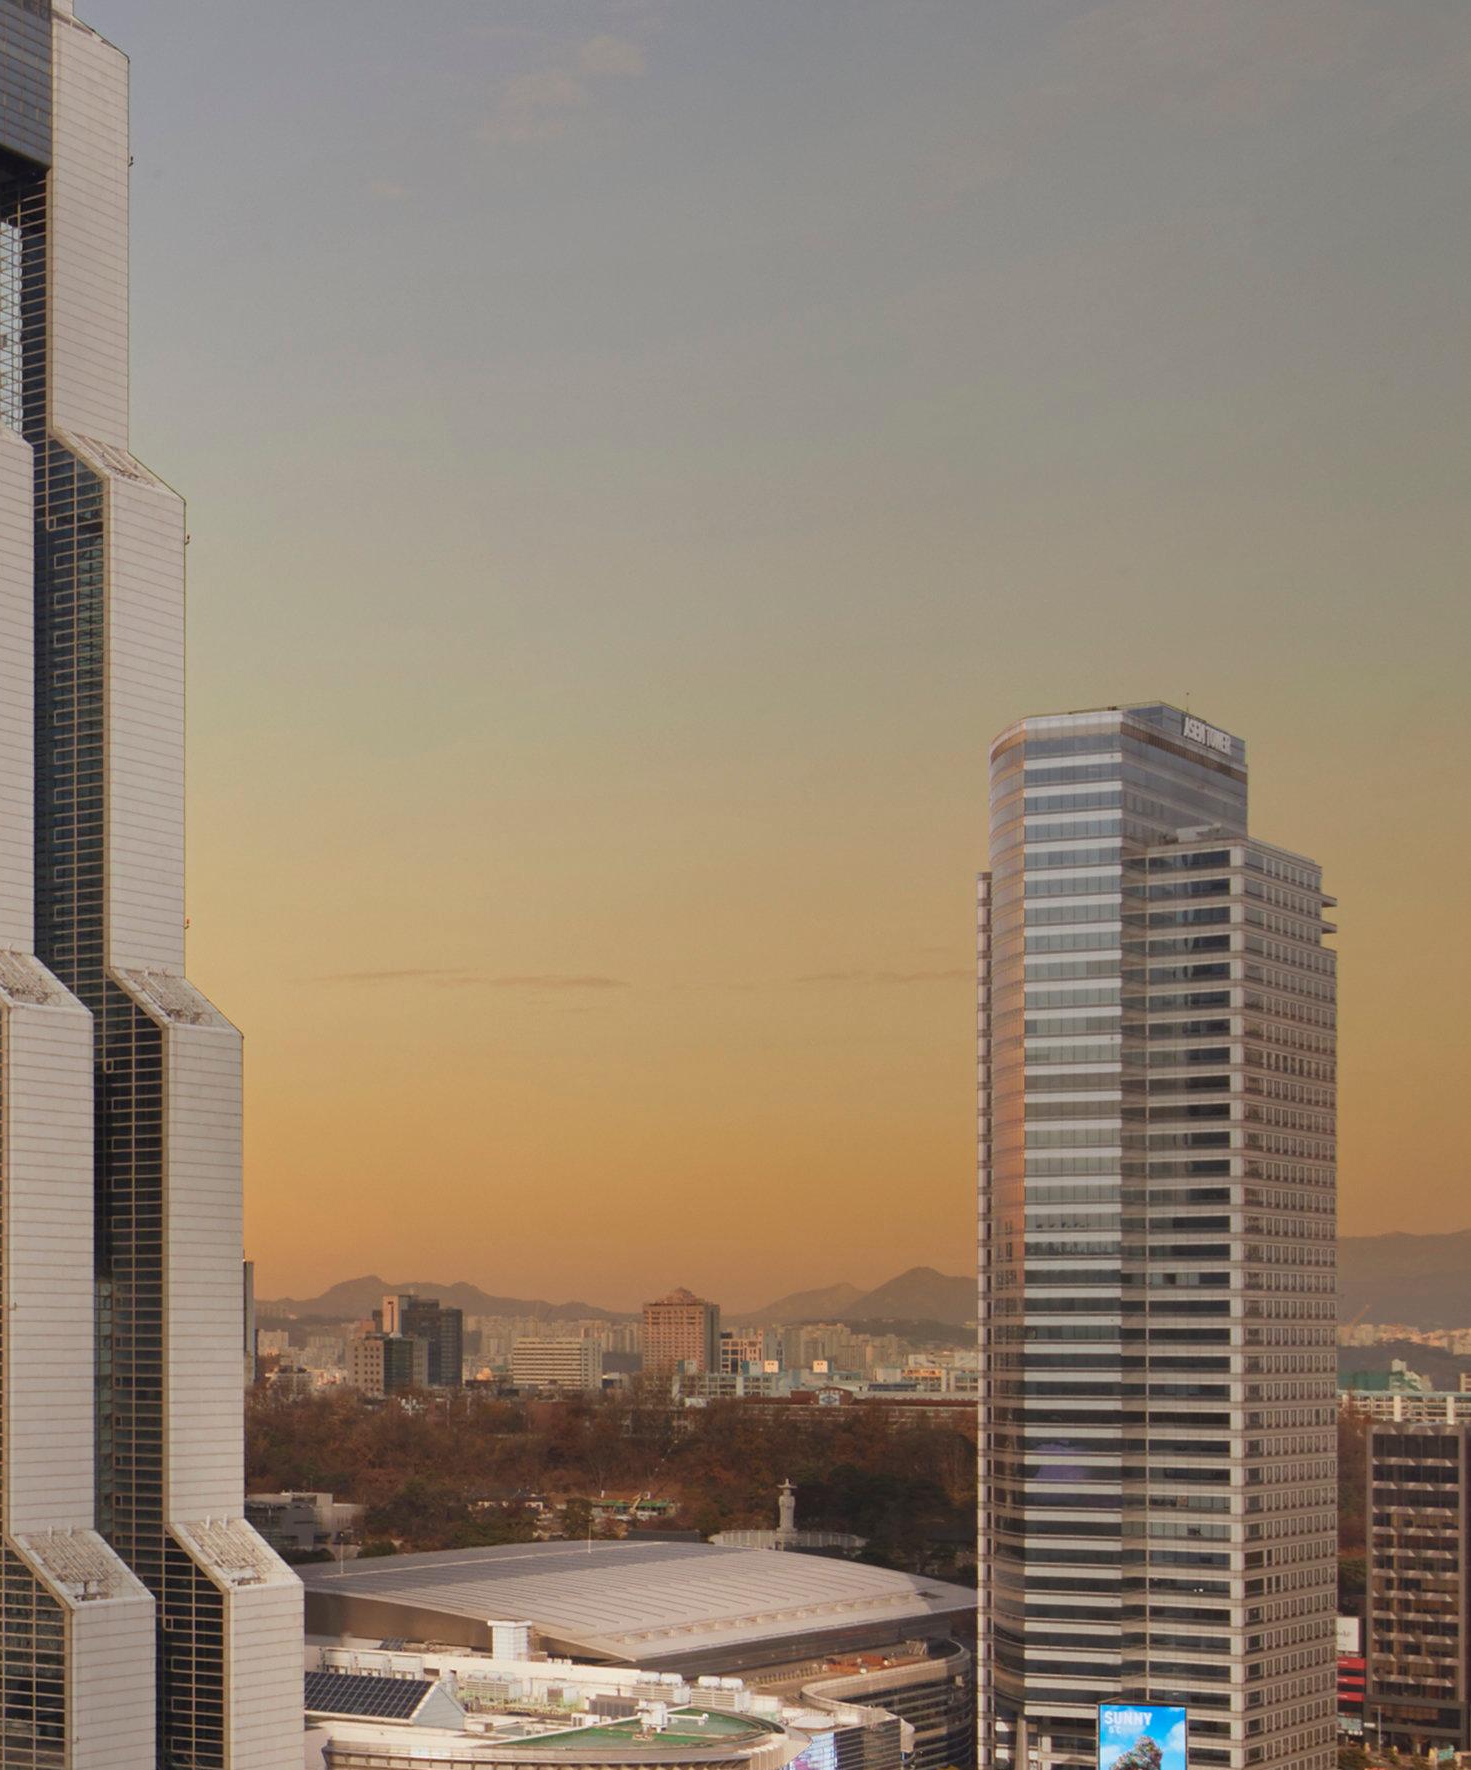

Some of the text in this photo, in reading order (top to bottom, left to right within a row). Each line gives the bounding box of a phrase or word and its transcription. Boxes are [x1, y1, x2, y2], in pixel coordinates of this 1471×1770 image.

[1184, 717, 1231, 756] ASEM TOWER
[1104, 1711, 1153, 1727] SUNNY
